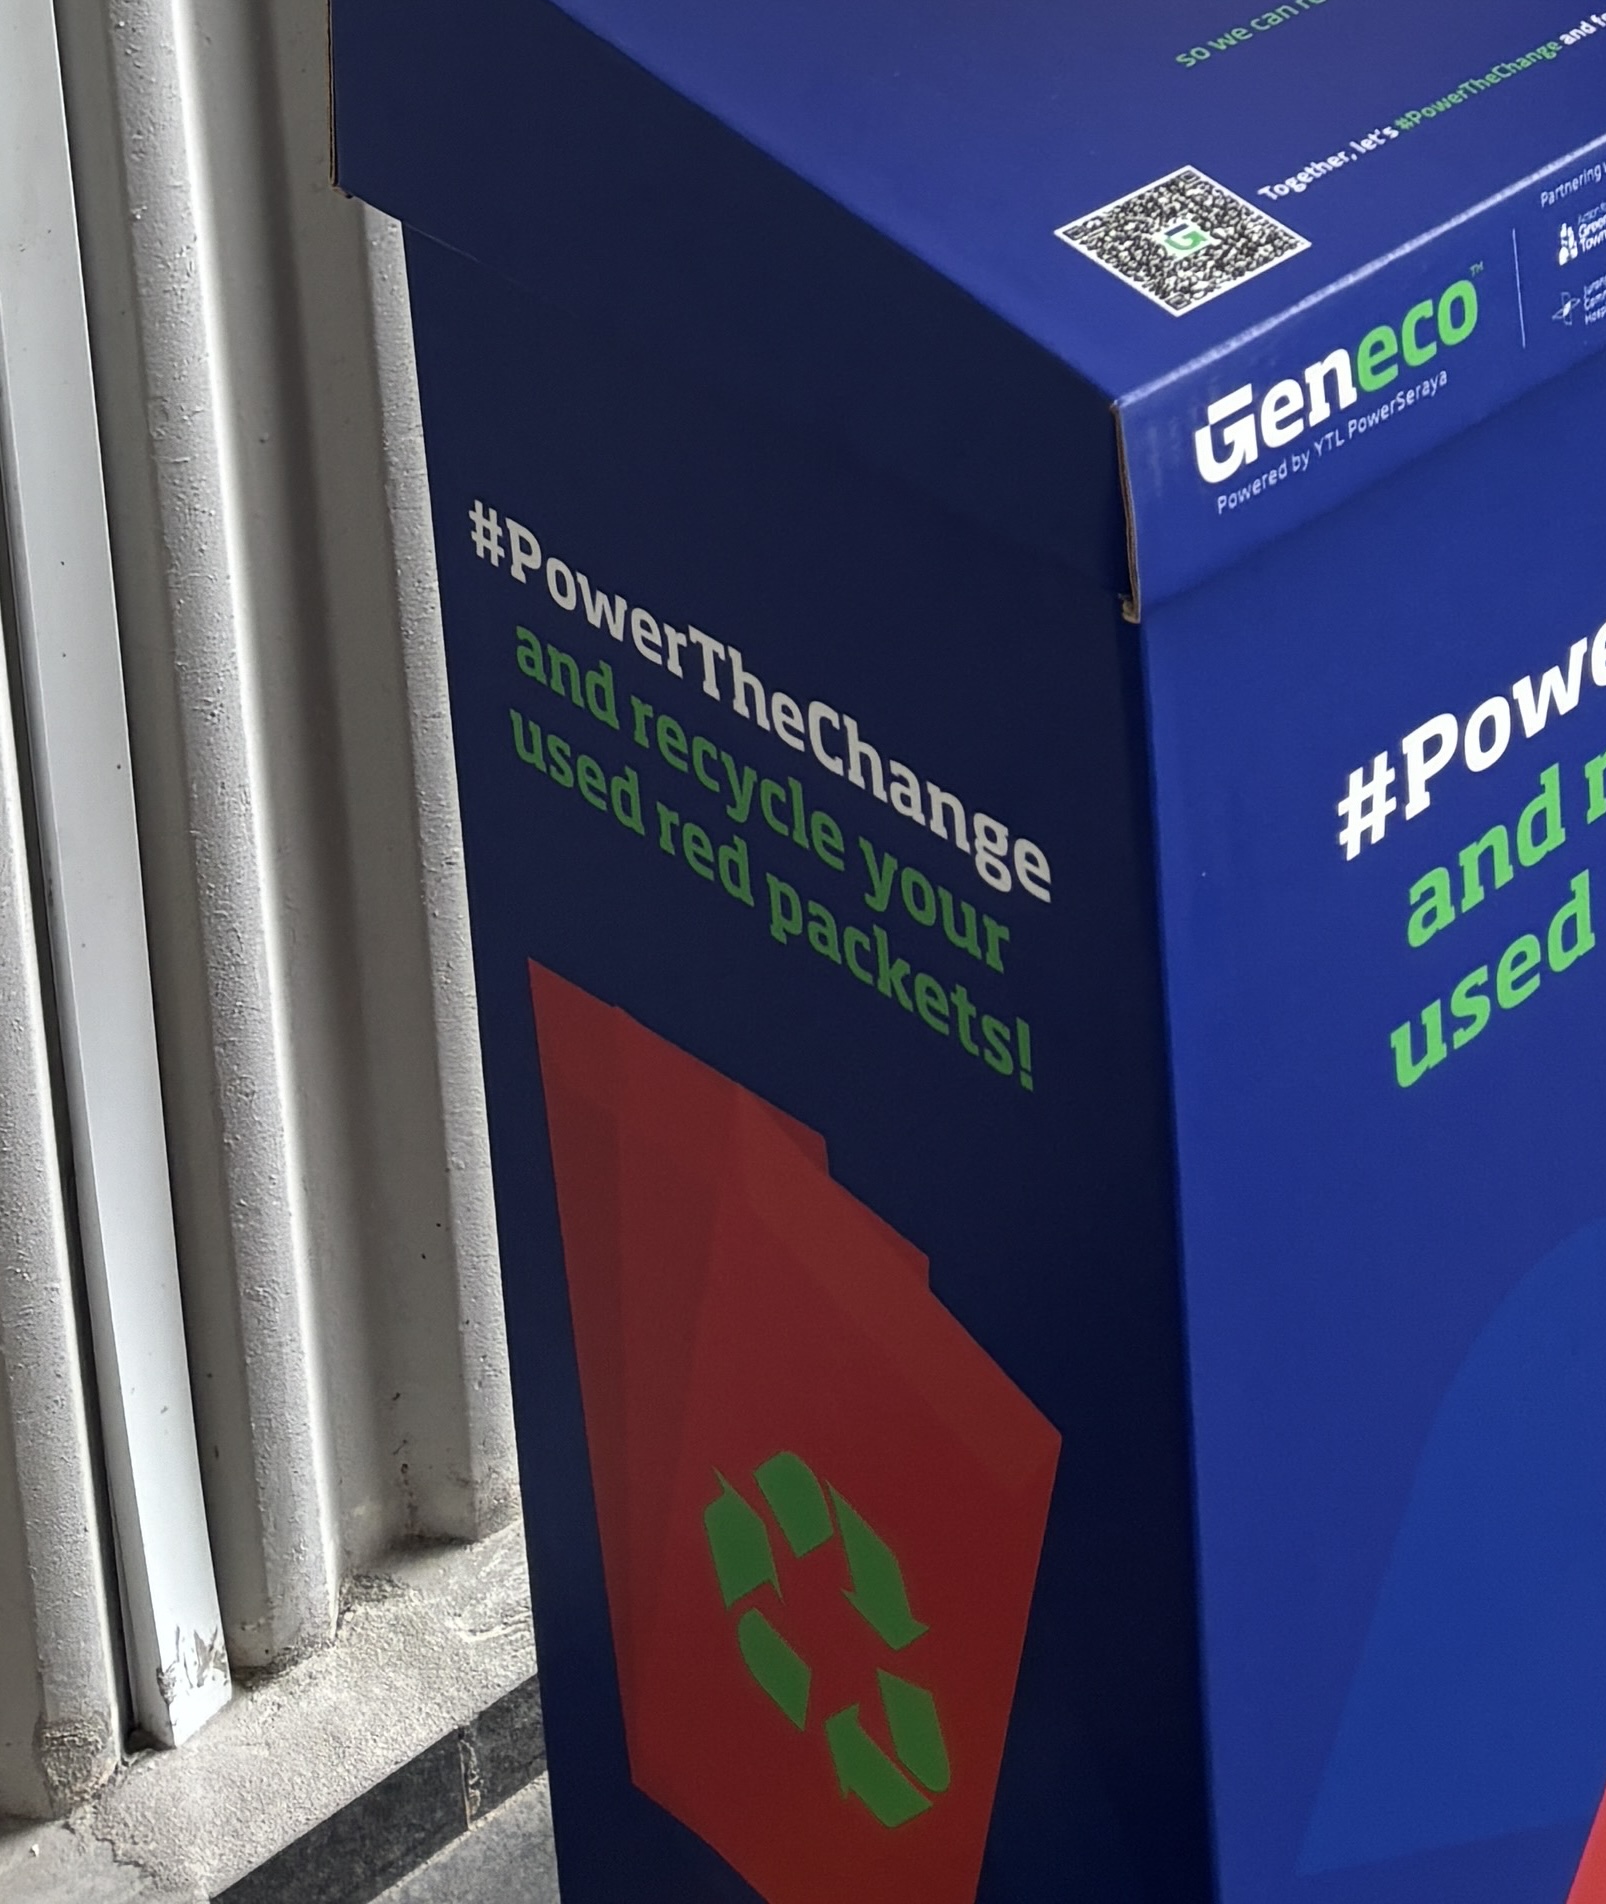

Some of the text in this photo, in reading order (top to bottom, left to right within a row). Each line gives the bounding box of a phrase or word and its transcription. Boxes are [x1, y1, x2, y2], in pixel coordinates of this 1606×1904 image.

[1175, 46, 1211, 69] so
[1208, 23, 1255, 54] we
[1250, 0, 1299, 32] can
[1258, 154, 1358, 202] Together,
[1395, 38, 1563, 132] #PowerTheChange
[1559, 20, 1596, 47] and
[1194, 279, 1478, 485] Geneco
[1217, 369, 1448, 515] Powered by YTL PowerSeraya
[468, 499, 1051, 904] #PowerTheChange
[515, 625, 1010, 973] and recycle your
[510, 709, 1033, 1092] used red packets!
[1407, 772, 1567, 950] and
[1389, 867, 1596, 1089] used
